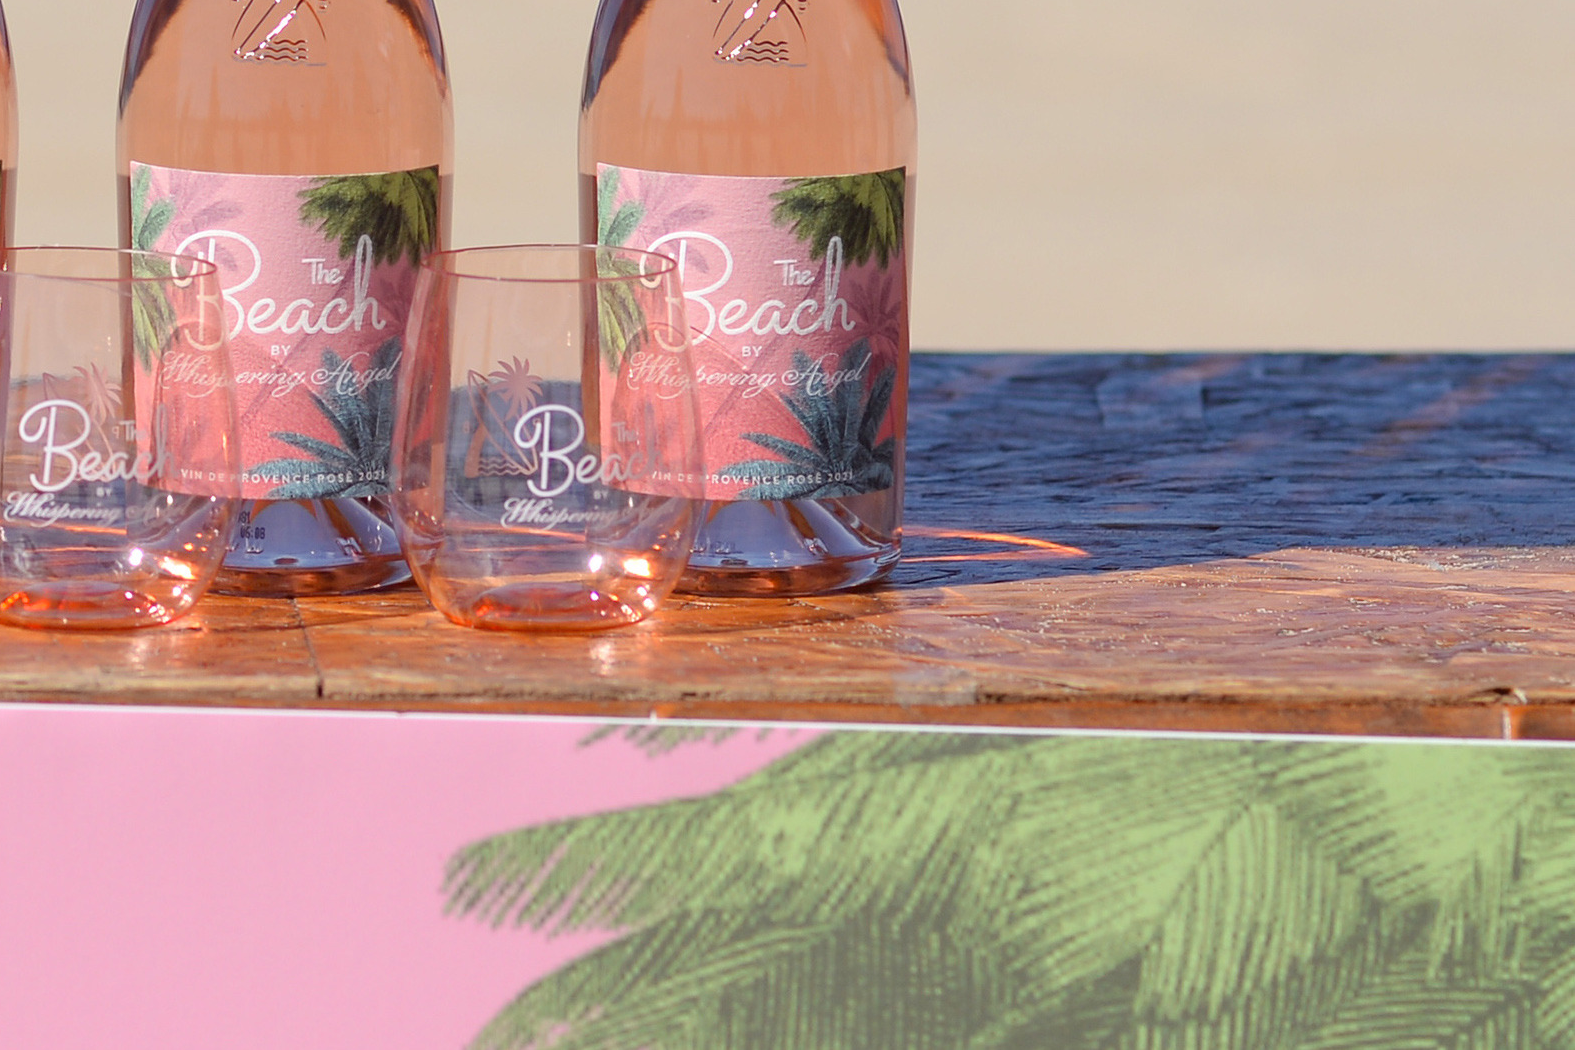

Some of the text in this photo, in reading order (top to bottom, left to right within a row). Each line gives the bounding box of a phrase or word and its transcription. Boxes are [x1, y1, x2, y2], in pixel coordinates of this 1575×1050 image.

[302, 257, 345, 285] The
[773, 259, 816, 287] The
[170, 229, 387, 351] Beach
[639, 231, 856, 352] Beach
[271, 345, 291, 356] BY
[742, 346, 762, 357] BY
[311, 351, 403, 396] Angel
[782, 352, 873, 397] Angel
[19, 399, 176, 492] Beach
[514, 404, 665, 497] Beach
[181, 468, 203, 480] VIN
[209, 472, 225, 482] DE
[317, 469, 353, 483] ROSÉ
[359, 468, 386, 481] 2021
[677, 473, 693, 483] DE
[787, 471, 822, 484] ROSÉ
[3, 491, 123, 528] Whispering
